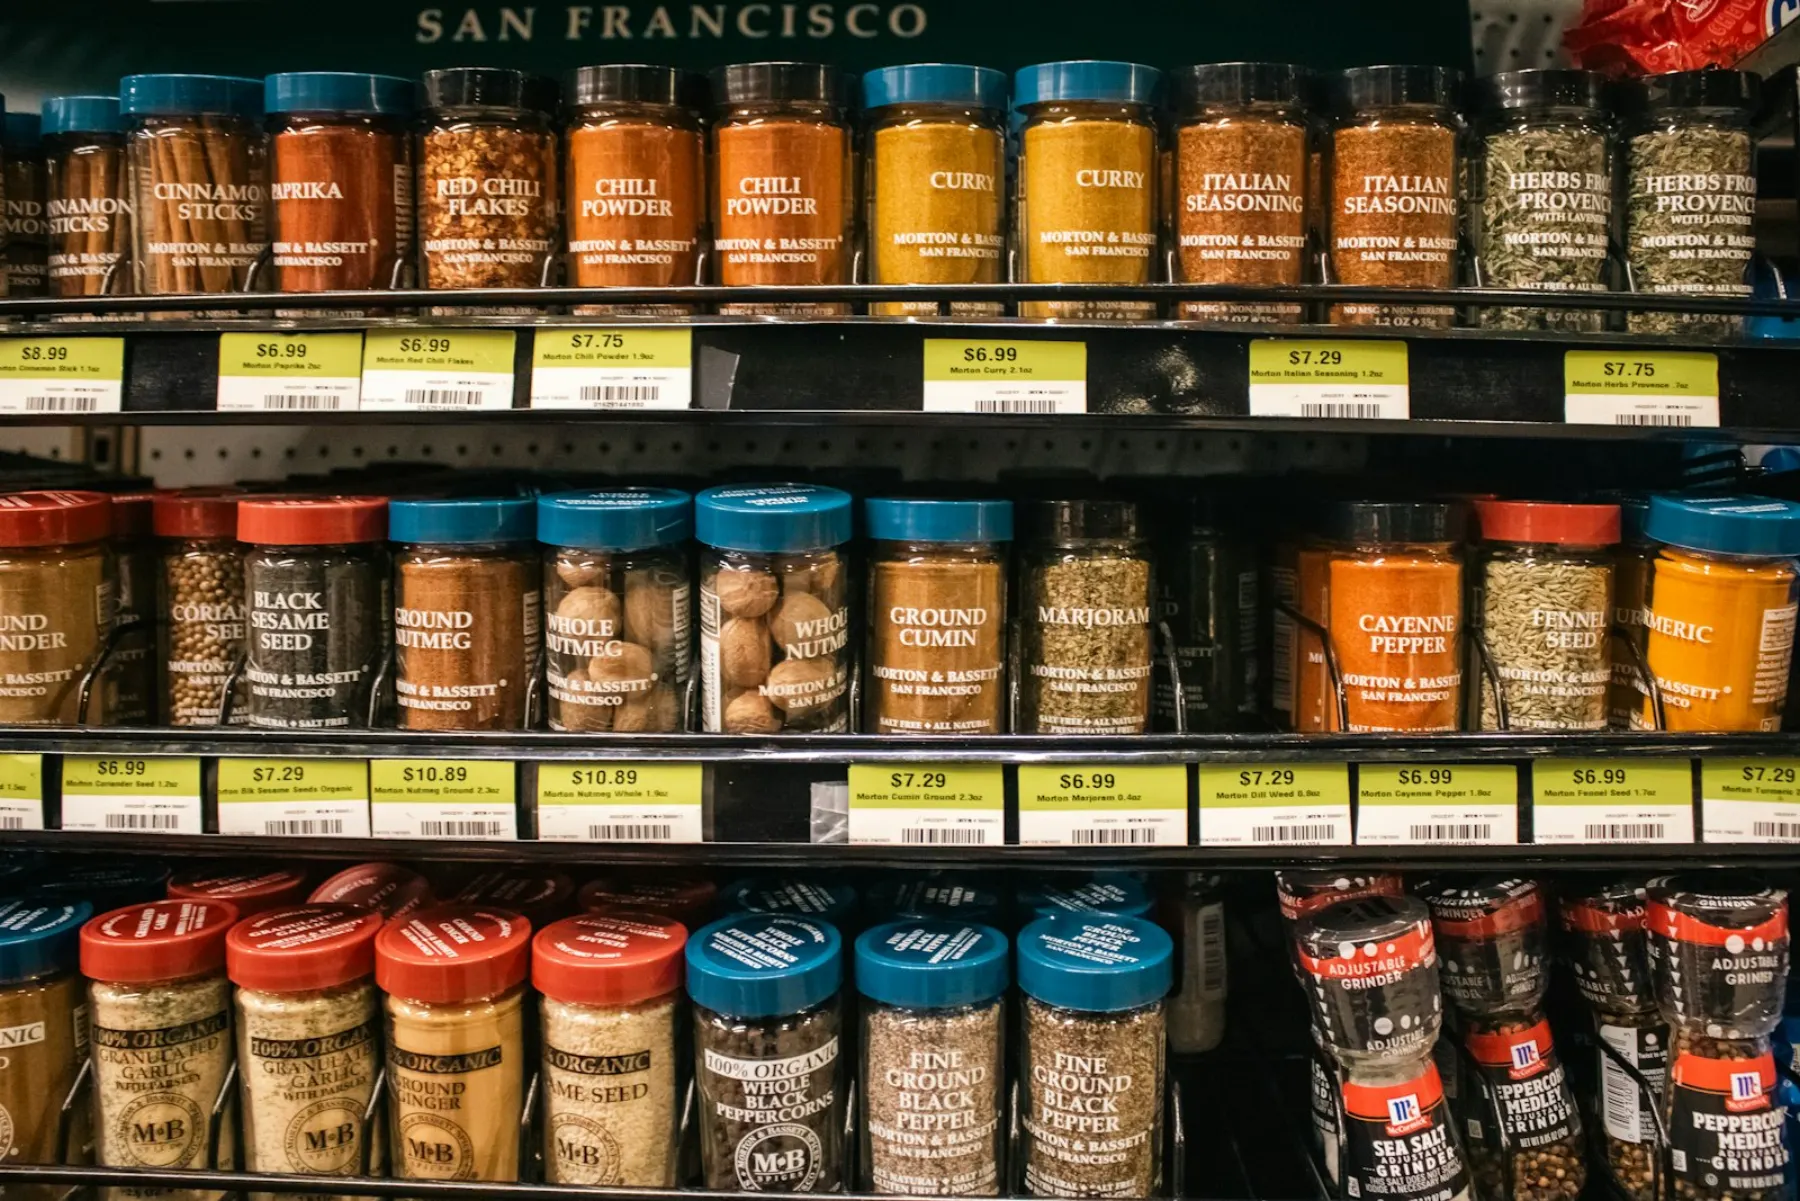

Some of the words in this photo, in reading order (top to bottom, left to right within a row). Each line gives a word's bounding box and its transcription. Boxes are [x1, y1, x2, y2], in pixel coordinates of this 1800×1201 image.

[416, 9, 534, 42] SAN
[566, 4, 928, 40] FRANCISCO
[437, 178, 478, 196] RED
[483, 178, 540, 197] CHILI
[595, 178, 657, 196] CHILI
[740, 177, 801, 195] CHILI
[930, 171, 995, 191] CURRY
[1076, 170, 1145, 188] CURRY
[1203, 173, 1291, 192] ITALIAN
[1363, 175, 1448, 194] ITALIAN
[1509, 171, 1581, 190] HERBS
[1646, 174, 1721, 194] HERBS
[272, 181, 343, 200] PAPRIKA
[178, 203, 255, 221] STICKS
[449, 198, 529, 216] FLAKES
[582, 199, 673, 217] POWDER
[727, 197, 818, 215] POWDER
[1186, 194, 1303, 213] SEASONING
[1344, 196, 1457, 216] SEASONING
[50, 217, 109, 234] STICKS
[1181, 235, 1239, 248] MORTON
[1242, 235, 1254, 246] &
[1258, 235, 1305, 248] BASSETT
[1201, 250, 1219, 260] SAN
[1221, 250, 1290, 260] FRANCISCO
[400, 338, 451, 353] $6.99
[571, 333, 624, 348] $7.75
[21, 346, 68, 361] $8.99
[256, 343, 307, 358] $6.99
[963, 347, 1017, 361] $6.99
[1289, 350, 1342, 365] $7.29
[273, 362, 305, 371] Paprika
[983, 367, 1007, 375] Curry
[1314, 370, 1358, 378] Seasoning
[1604, 362, 1655, 376] $7.75
[253, 591, 322, 610] BLACK
[251, 612, 330, 631] SESAME
[395, 607, 473, 629] GROUND
[546, 612, 613, 637] WHOLE
[890, 607, 987, 627] GROUND
[1039, 606, 1150, 629] MARJORAM
[1359, 614, 1455, 634] CAYENNE
[1532, 609, 1607, 628] FENNEL
[261, 633, 313, 651] SEED
[395, 628, 472, 650] NUTMEG
[546, 632, 623, 658] NUTMEG
[900, 628, 978, 647] CUMIN
[1371, 635, 1446, 655] PEPPER
[1546, 631, 1597, 649] SEED
[873, 665, 928, 682] MORTON
[931, 671, 944, 682] &
[947, 667, 998, 682] BASSETT
[890, 684, 913, 694] SAN
[916, 684, 982, 696] FRANCISCO
[97, 760, 146, 775] $6.99
[253, 766, 304, 781] $7.29
[403, 766, 467, 781] $10.89
[1398, 769, 1452, 784] $6.99
[1573, 769, 1626, 784] $6.99
[1743, 767, 1796, 783] $7.29
[572, 770, 637, 785] $10.89
[891, 773, 946, 788] $7.29
[1060, 773, 1115, 789] $6.99
[1240, 770, 1295, 786] $7.29
[1072, 795, 1115, 803] Marjoram
[1395, 790, 1432, 798] Cayenne
[1435, 790, 1466, 798] Pepper
[1329, 956, 1406, 977] ADJUSTABLE
[1712, 955, 1778, 971] ADJUSTABLE
[1341, 971, 1403, 990] GRINDER
[100, 1036, 219, 1066] GRANULATED
[253, 1039, 298, 1059] 100%
[405, 1046, 500, 1074] ORGANIC
[556, 1052, 650, 1075] ORGANIC
[707, 1053, 748, 1077] 100%
[754, 1042, 838, 1078] ORGANIC
[910, 1051, 962, 1070] FINE
[1055, 1052, 1107, 1075] FINE
[122, 1061, 192, 1080] GARLIC
[291, 1063, 360, 1090] GARLIC
[885, 1065, 986, 1090] GROUND
[1034, 1065, 1132, 1094] GROUND
[592, 1082, 649, 1103] SEED
[742, 1074, 811, 1096] WHOLE
[398, 1092, 461, 1111] GINGER
[716, 1090, 834, 1124] PEPPERCORNS
[745, 1090, 809, 1110] BLACK
[899, 1090, 975, 1111] BLACK
[1043, 1089, 1119, 1114] BLACK
[1505, 1086, 1563, 1115] MEDLEY
[896, 1110, 975, 1130] PEPPER
[1041, 1108, 1120, 1133] PEPPER
[1373, 1138, 1410, 1158] SEA
[1412, 1124, 1447, 1152] SALT
[1718, 1129, 1781, 1151] MEDLEY
[1376, 1148, 1455, 1178] GRINDER
[1711, 1150, 1790, 1172] GRINDER
